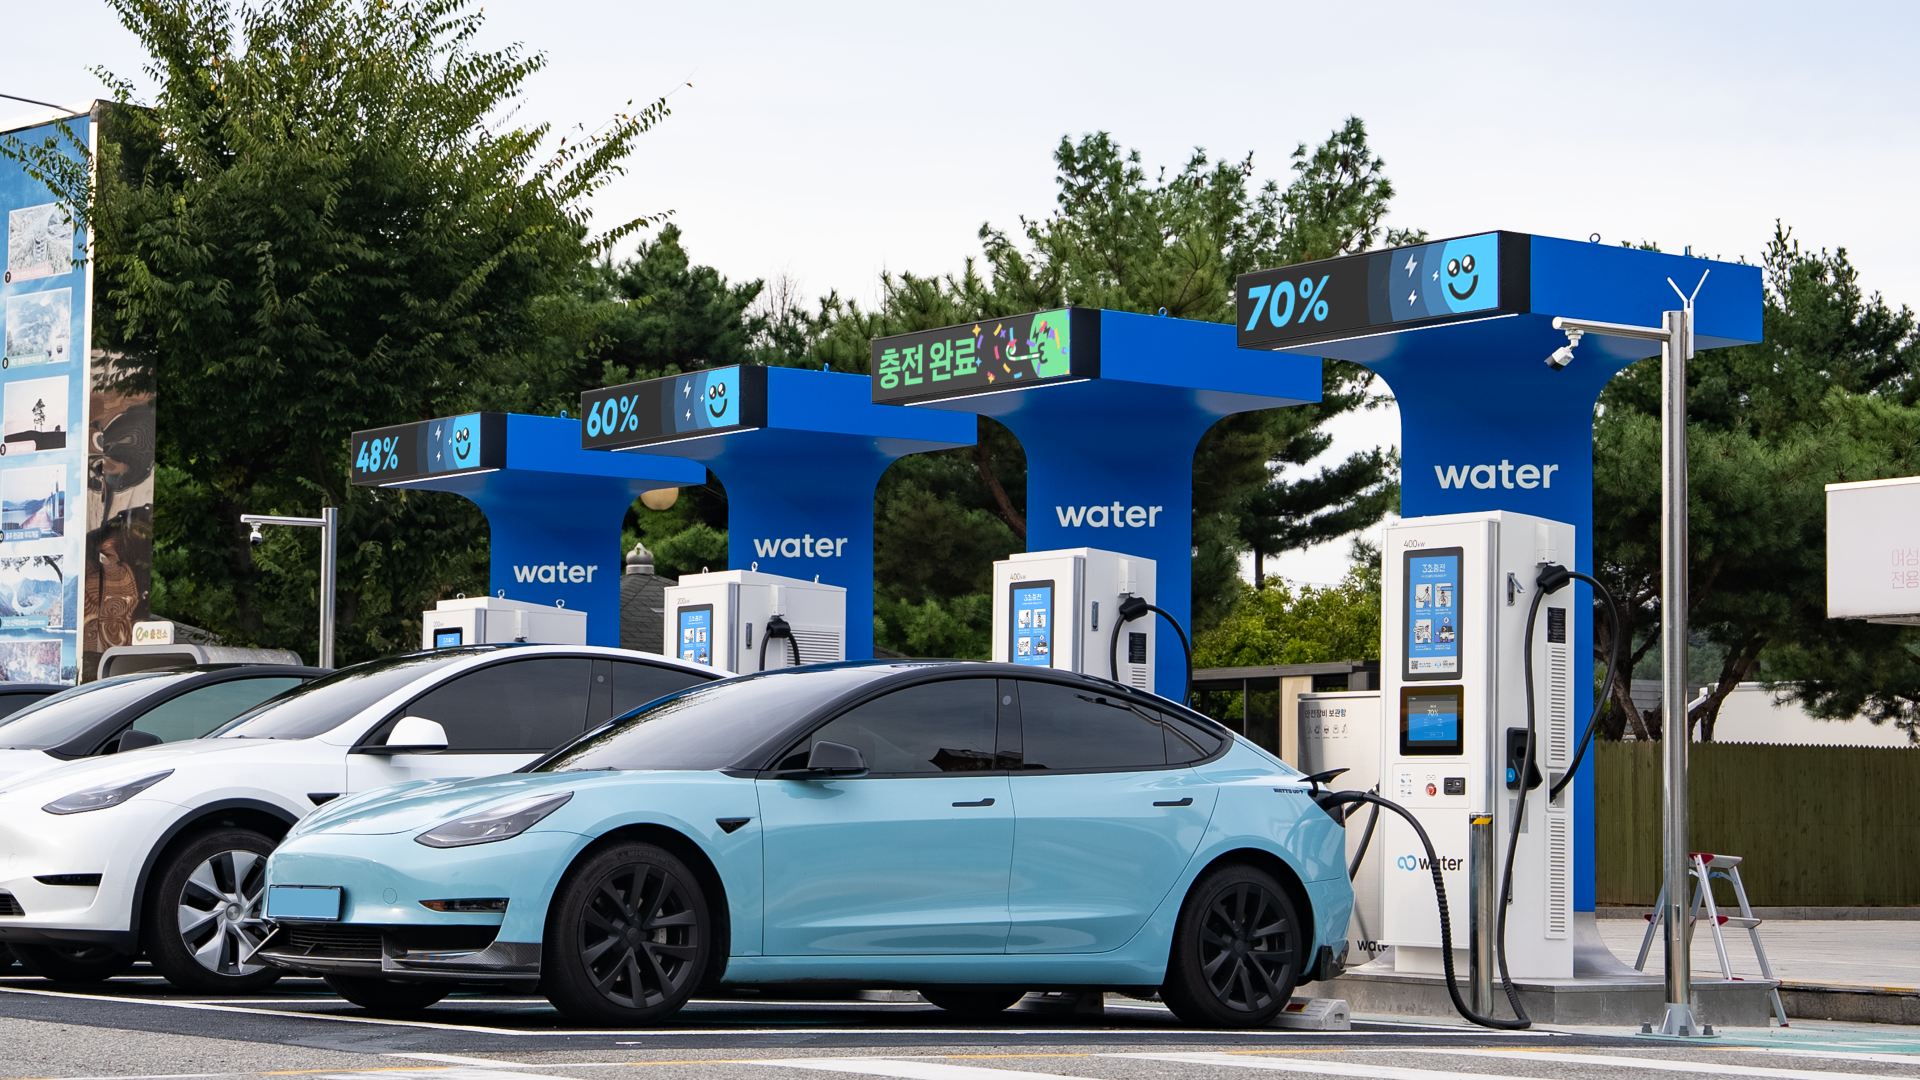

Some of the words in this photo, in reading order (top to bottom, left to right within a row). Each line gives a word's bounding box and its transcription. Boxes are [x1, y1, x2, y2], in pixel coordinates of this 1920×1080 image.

[1245, 275, 1329, 332] 70%
[879, 343, 924, 389] 충전
[929, 337, 977, 381] 완료
[586, 394, 639, 438] 60%
[356, 436, 399, 473] 48%
[1434, 459, 1559, 490] water
[1056, 500, 1163, 527] water
[753, 533, 848, 559] water
[1891, 548, 1919, 567] 여성
[513, 560, 598, 584] water
[1891, 570, 1919, 590] 전용
[150, 628, 168, 640] 충전소
[627, 850, 667, 863] MICHELIN
[1418, 855, 1464, 871] wter
